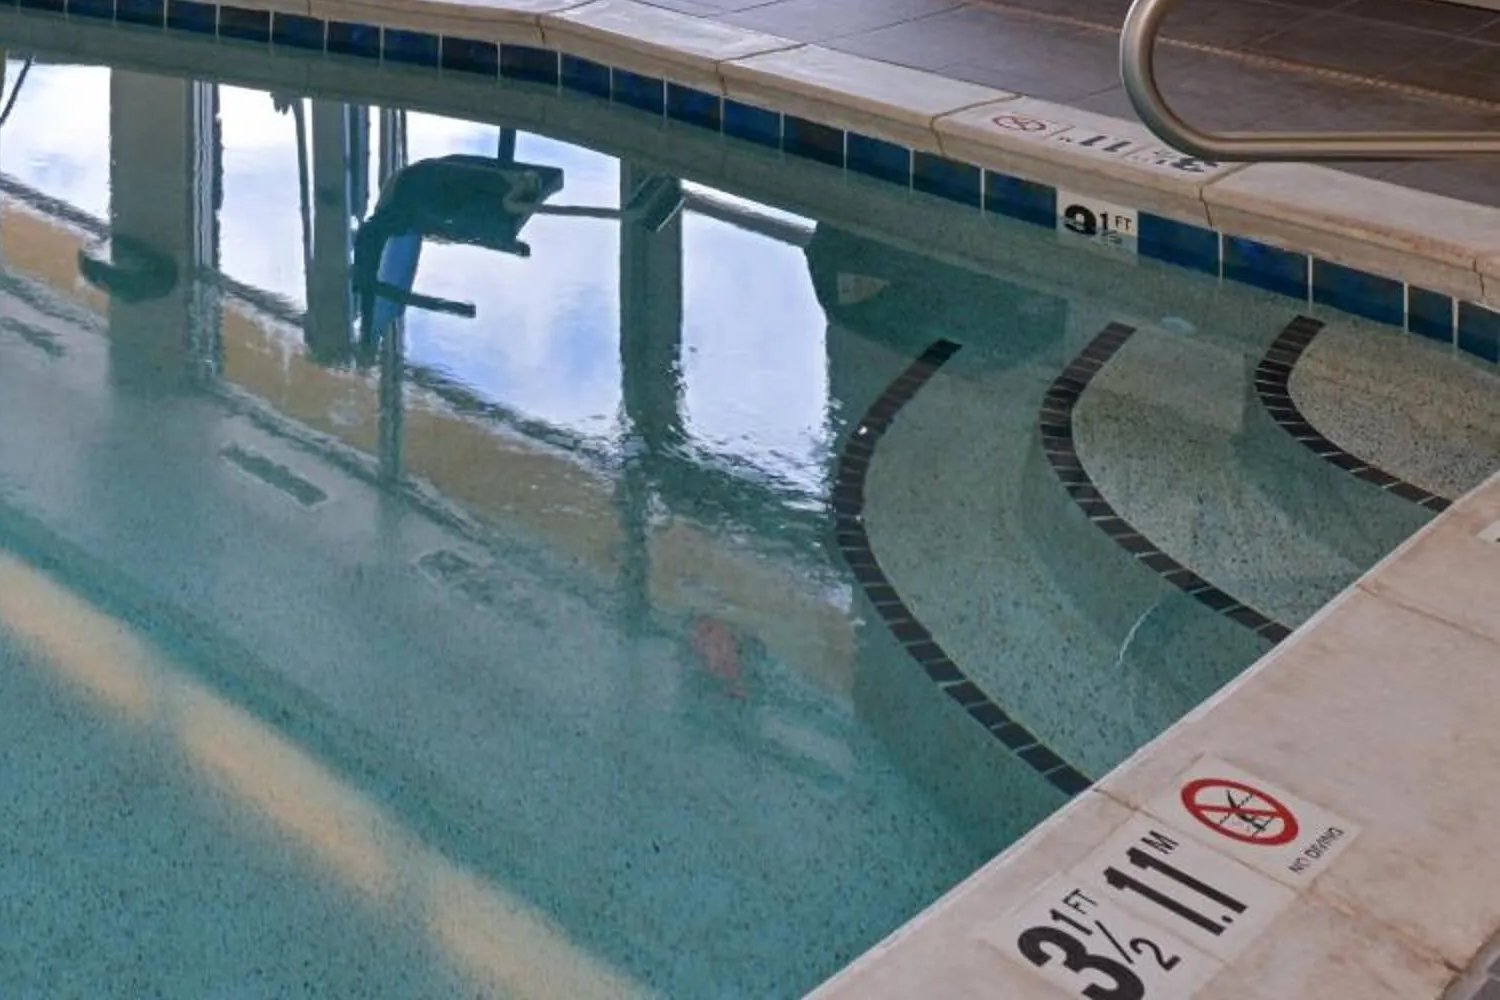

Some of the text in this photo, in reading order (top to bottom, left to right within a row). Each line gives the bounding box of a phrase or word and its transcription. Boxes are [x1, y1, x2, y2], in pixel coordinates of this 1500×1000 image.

[1287, 826, 1345, 874] NO DIVING
[1062, 887, 1098, 916] FT
[1102, 829, 1248, 937] 1.1 M
